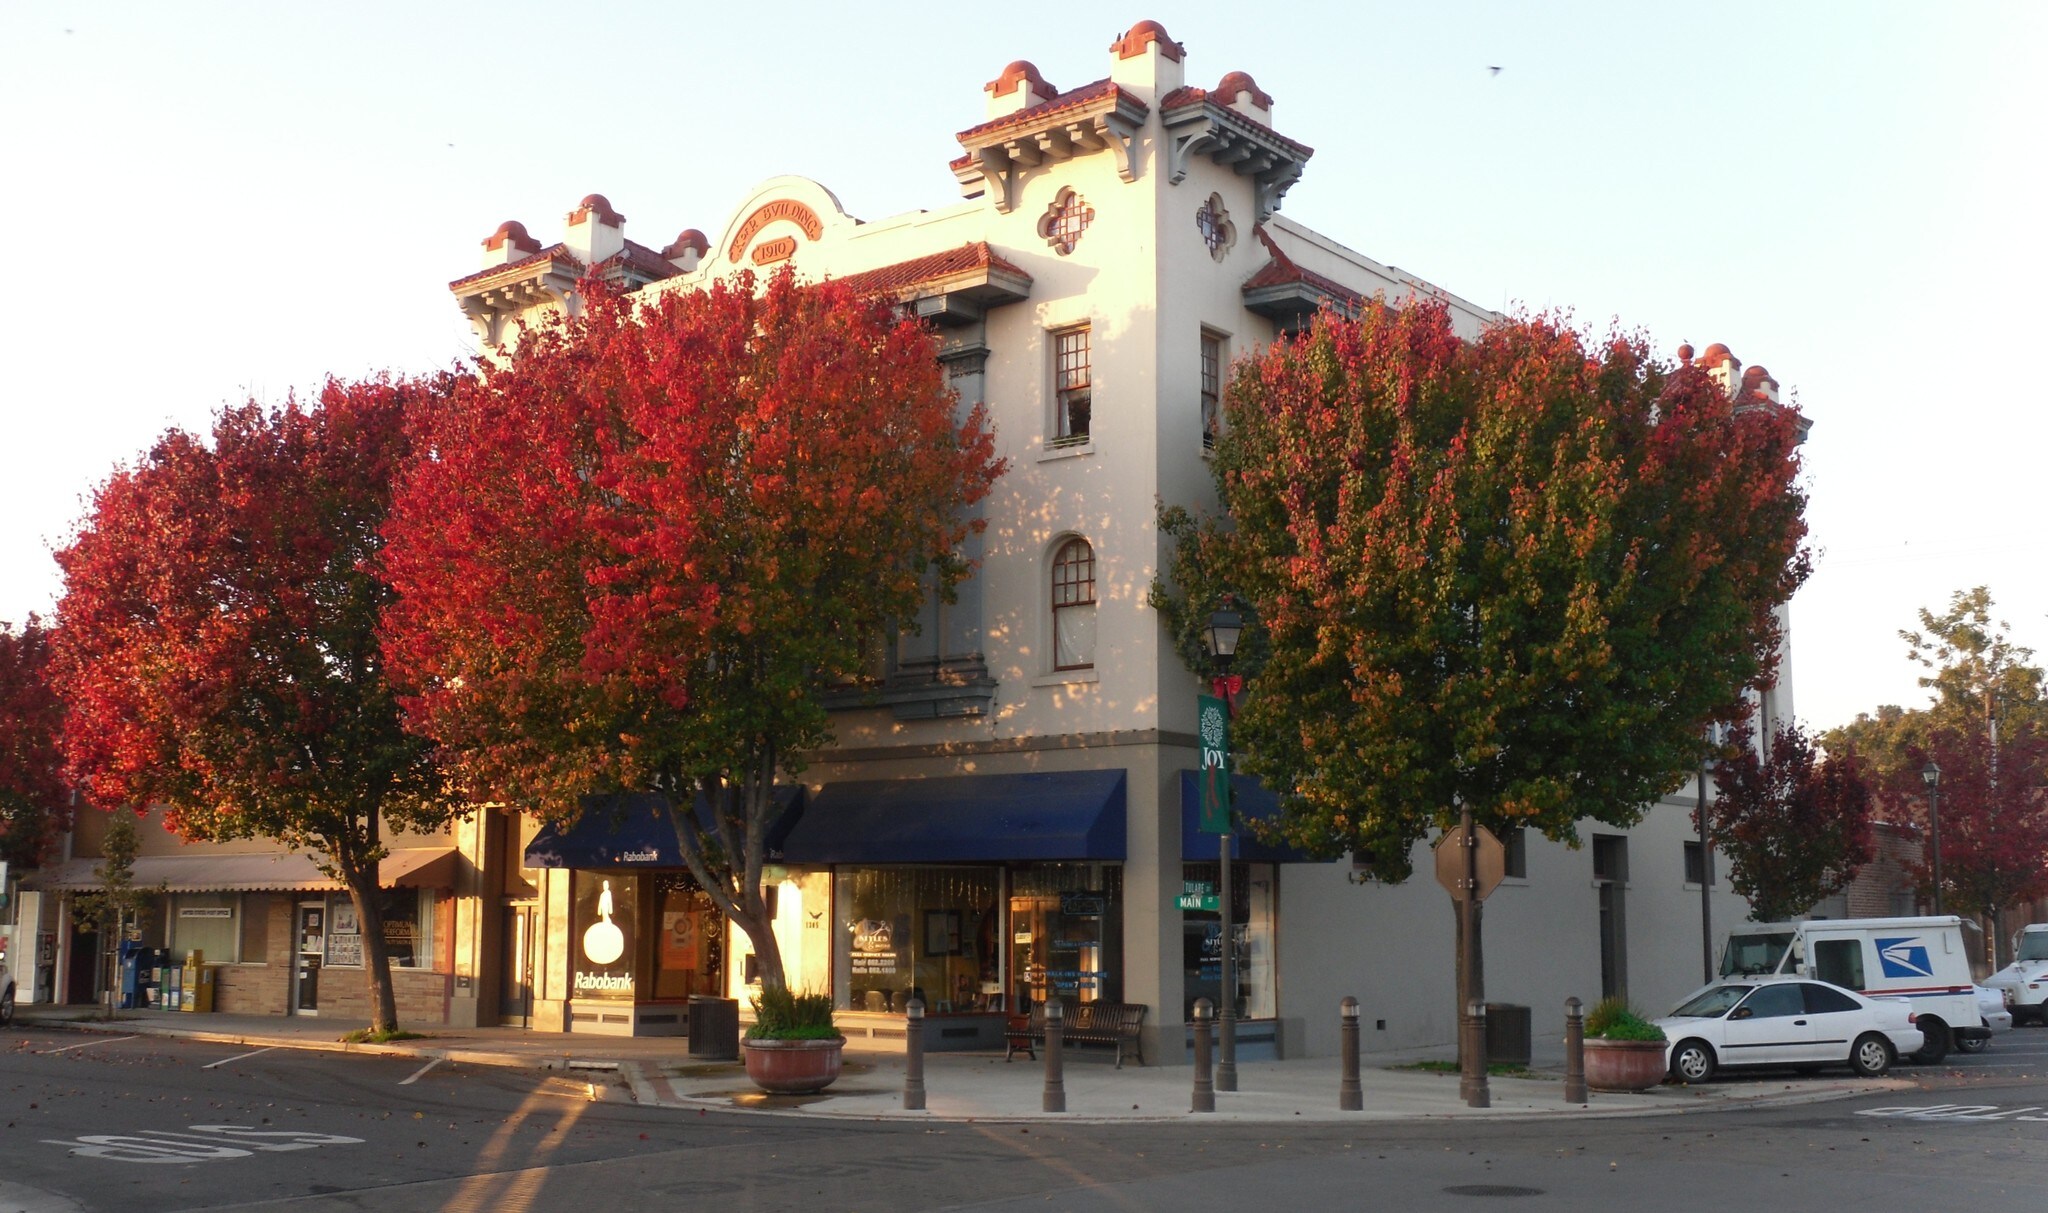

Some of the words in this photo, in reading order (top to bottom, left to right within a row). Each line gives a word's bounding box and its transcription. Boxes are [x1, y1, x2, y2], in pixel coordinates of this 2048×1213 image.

[761, 242, 786, 260] 1910
[1201, 747, 1225, 770] JOY
[623, 850, 658, 862] Rabobank
[1179, 897, 1201, 908] MAIN
[574, 971, 633, 990] Rabobank
